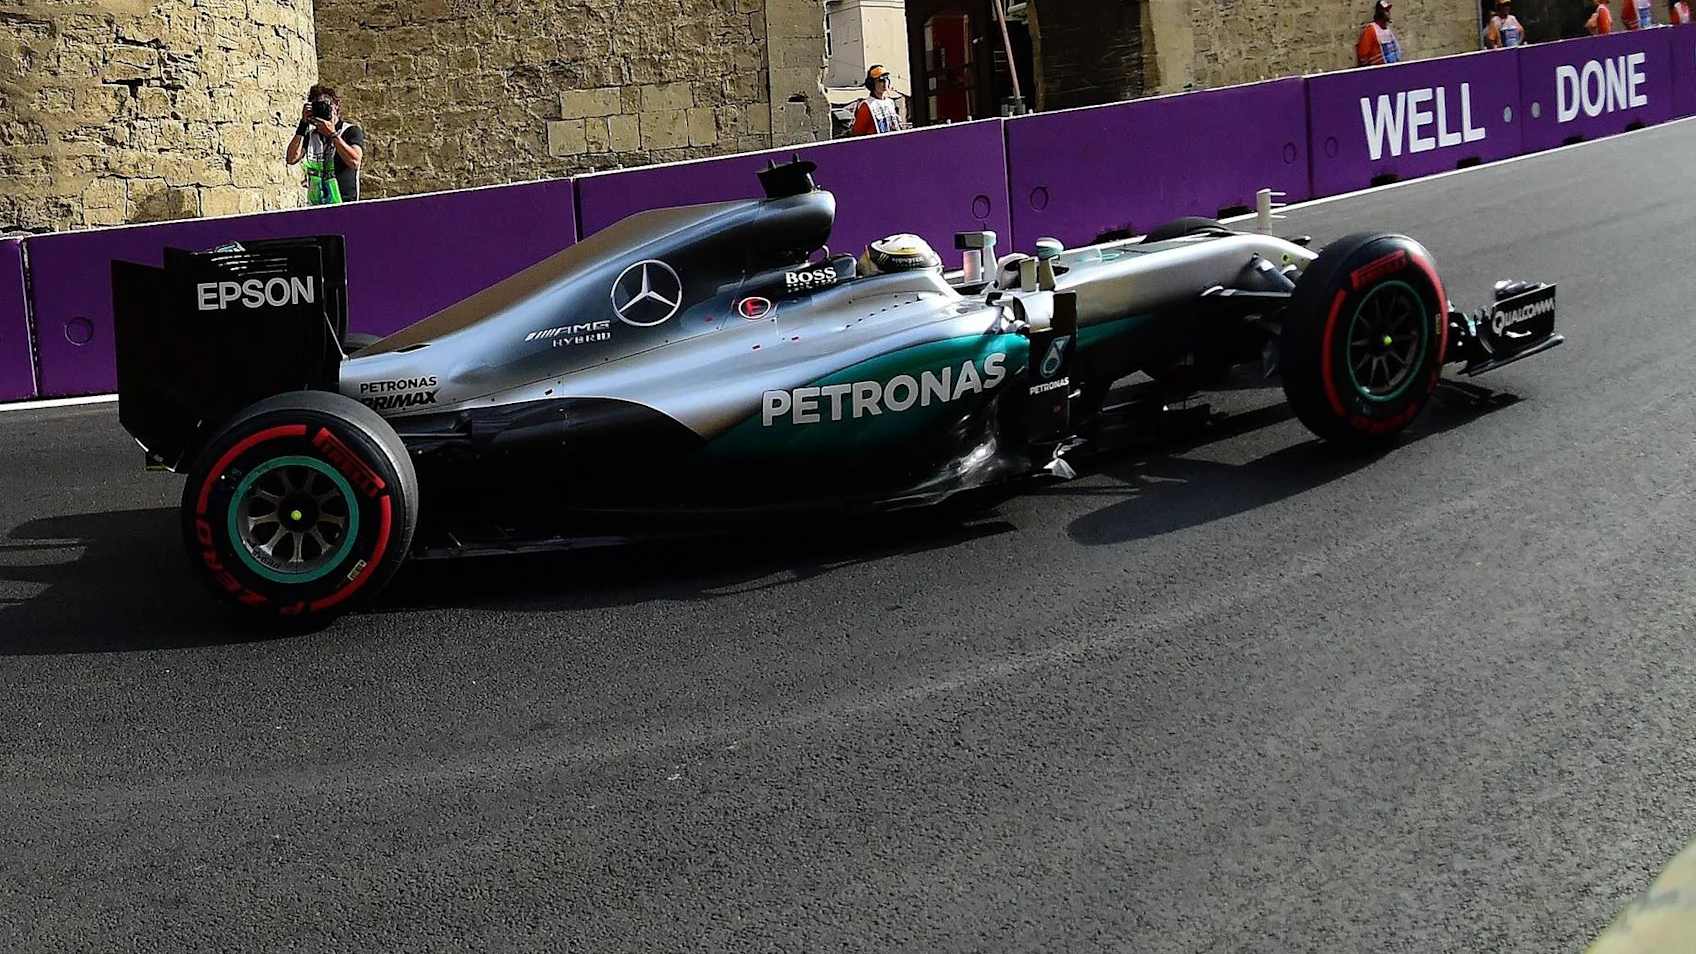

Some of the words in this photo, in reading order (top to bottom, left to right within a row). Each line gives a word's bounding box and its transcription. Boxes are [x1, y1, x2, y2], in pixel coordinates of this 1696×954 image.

[1360, 82, 1486, 160] WELL
[1556, 52, 1647, 123] DONE
[785, 266, 837, 284] BOSS
[197, 275, 315, 311] EPSON
[552, 332, 611, 348] HYBRID
[359, 376, 437, 394] PETRONAS
[762, 352, 1006, 427] PETRONAS
[1029, 376, 1070, 396] PETRONAS
